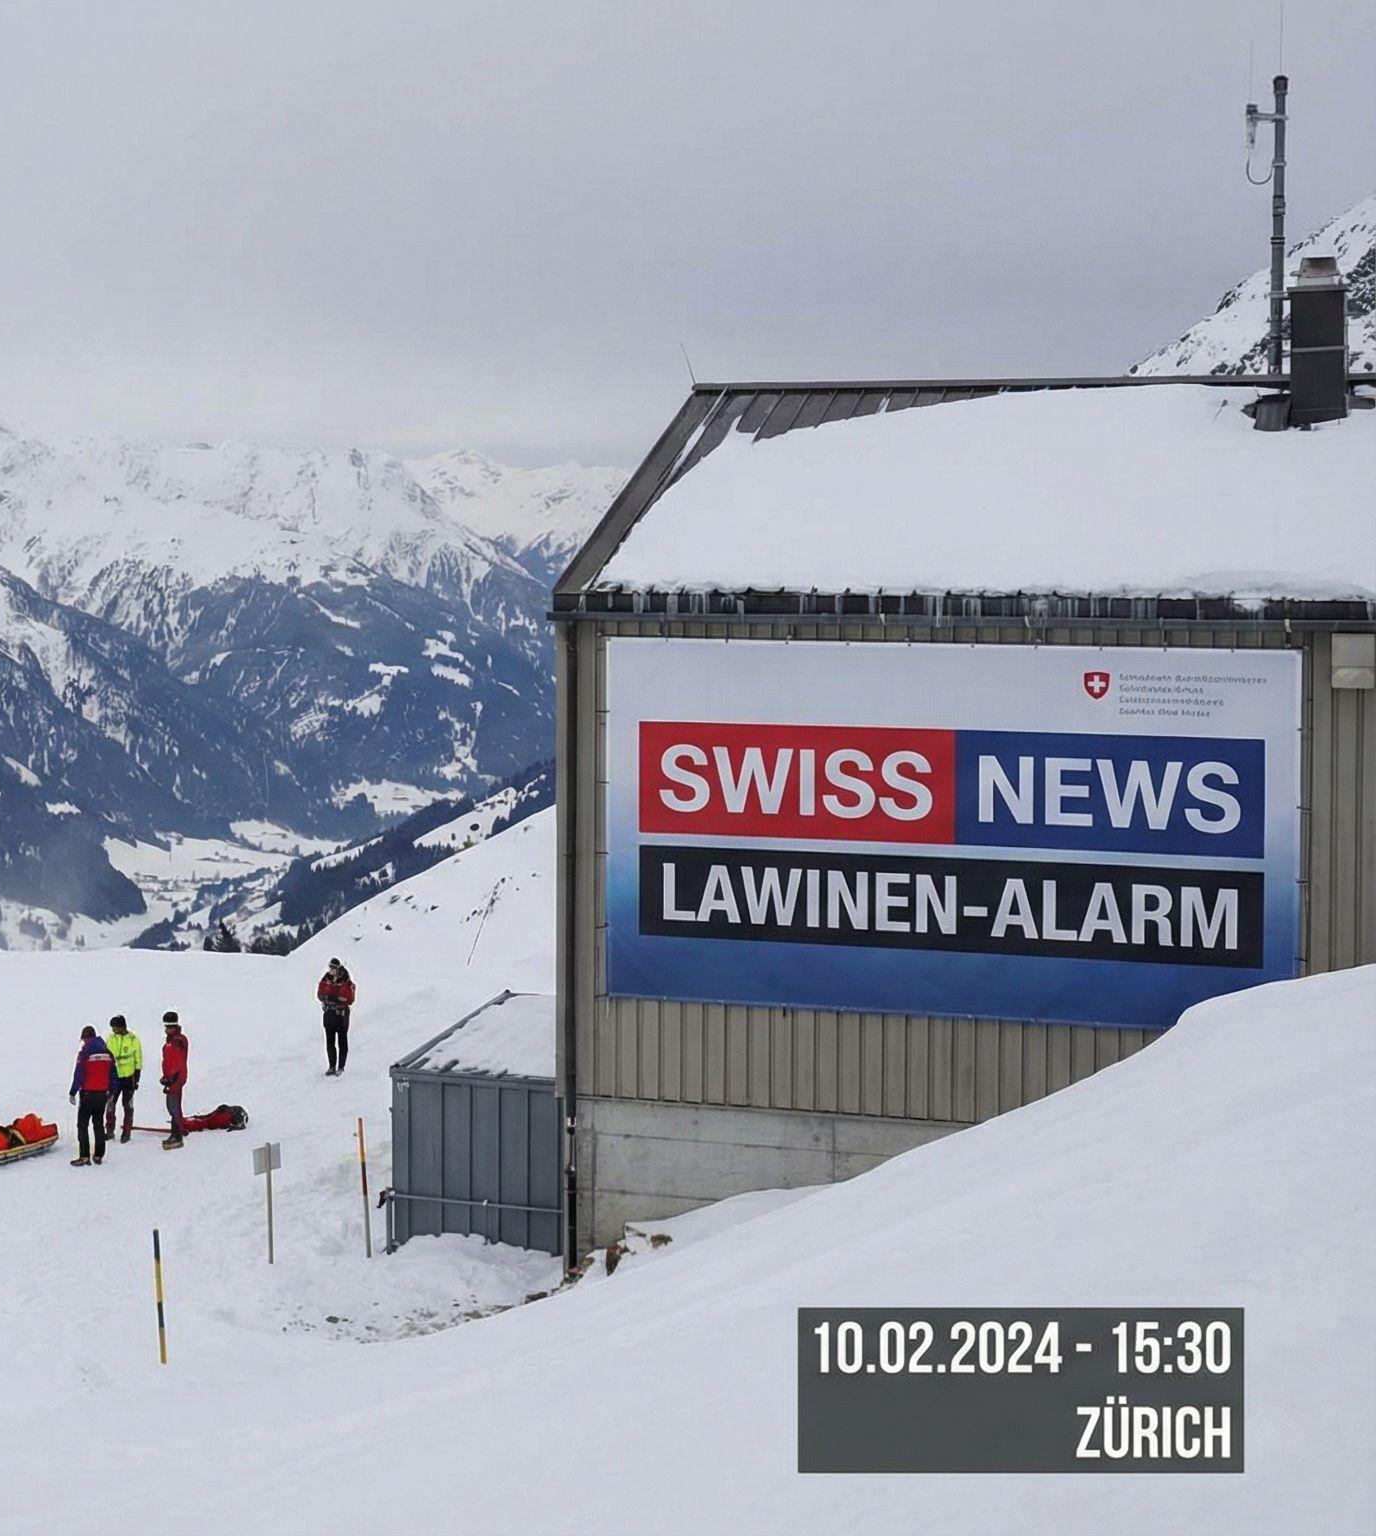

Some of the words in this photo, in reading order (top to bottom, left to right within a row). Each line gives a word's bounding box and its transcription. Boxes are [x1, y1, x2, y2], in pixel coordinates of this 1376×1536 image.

[659, 743, 933, 821] SWISS
[978, 755, 1241, 834] NEWS
[662, 862, 1238, 950] LAWINEN-ALARM
